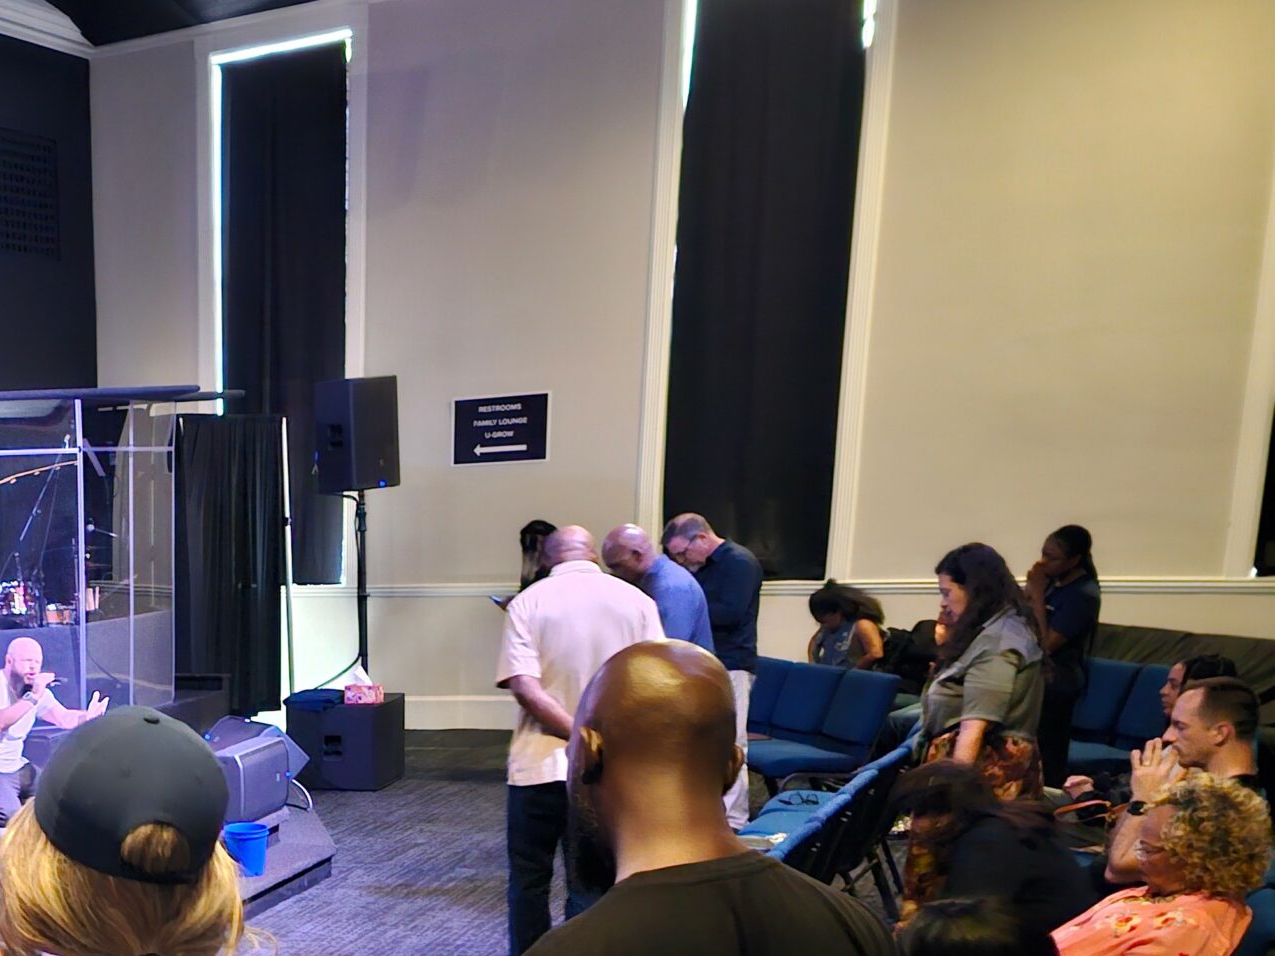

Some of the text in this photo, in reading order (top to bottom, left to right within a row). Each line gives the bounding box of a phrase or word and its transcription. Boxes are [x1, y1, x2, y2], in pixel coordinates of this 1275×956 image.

[478, 403, 522, 412] RESTROOMS
[473, 417, 527, 427] FAMILY LOUNGE
